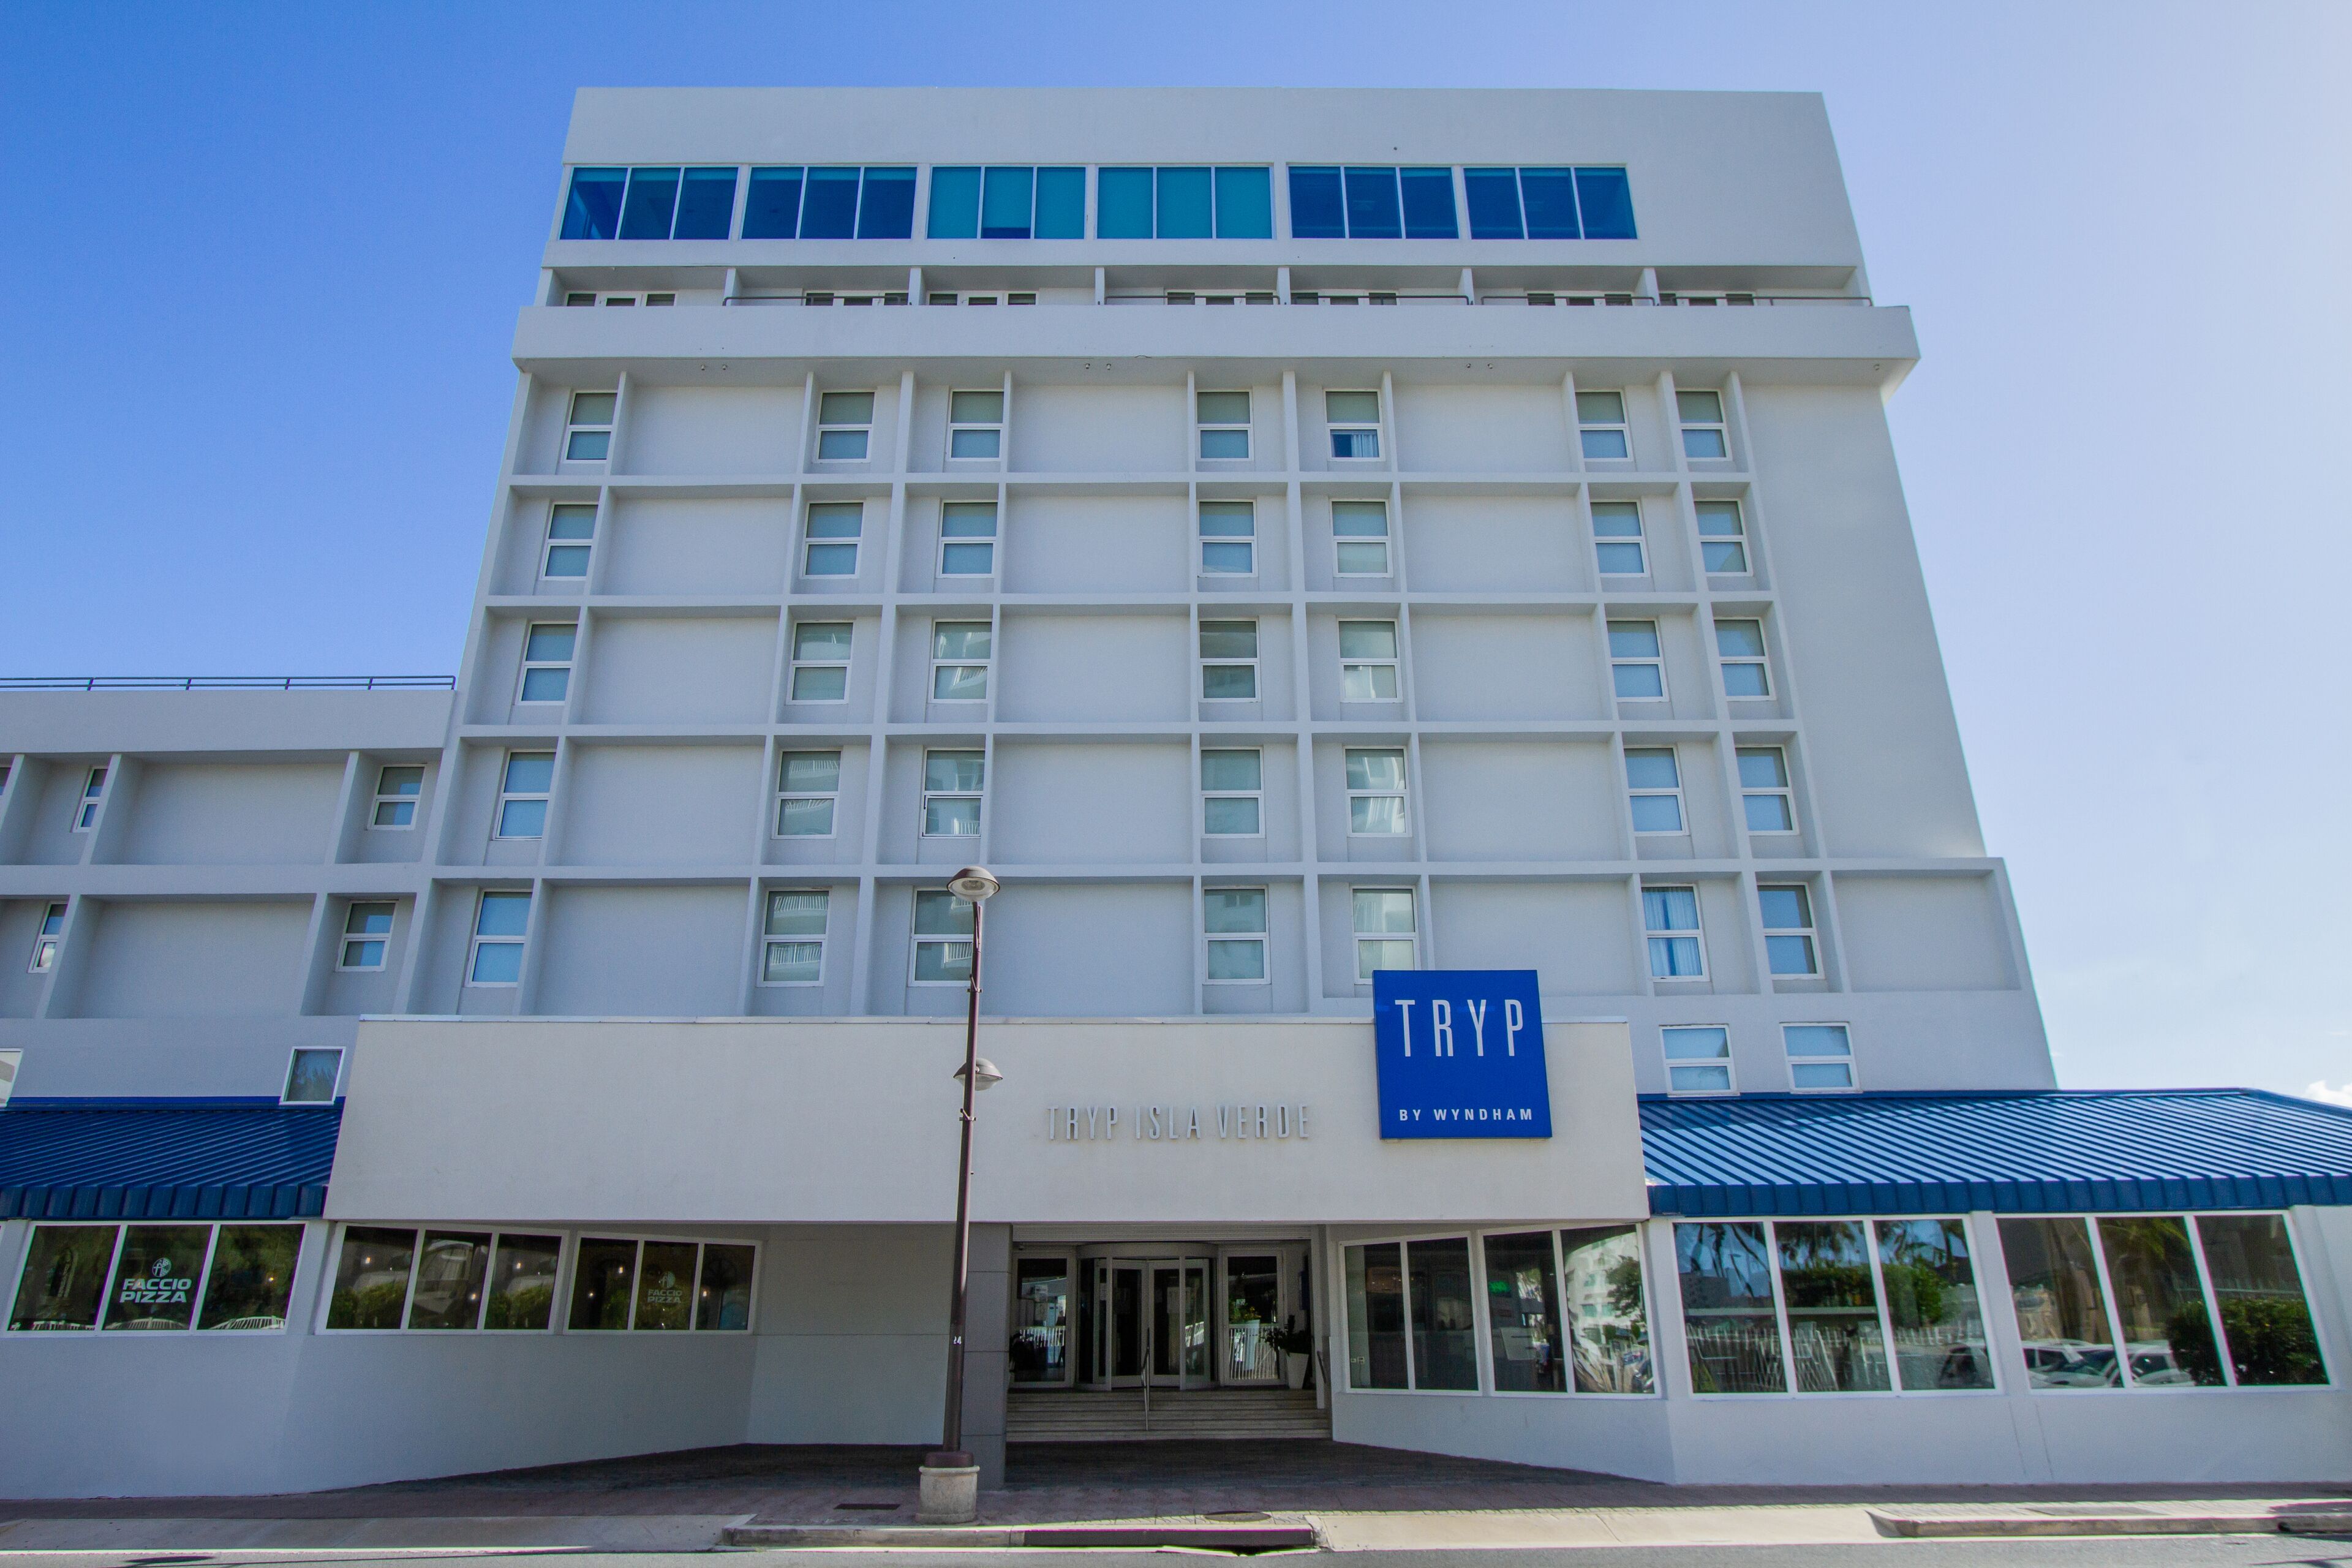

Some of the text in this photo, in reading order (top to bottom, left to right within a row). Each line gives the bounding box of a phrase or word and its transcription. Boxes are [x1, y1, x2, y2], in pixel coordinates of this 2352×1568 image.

[1395, 999, 1523, 1057] TRYP
[1400, 1109, 1532, 1121] BY WYNDHAM
[1047, 1105, 1310, 1140] TRYP ISLA VERDE
[123, 1278, 192, 1290] FACCIO
[119, 1291, 187, 1303] PIZZA
